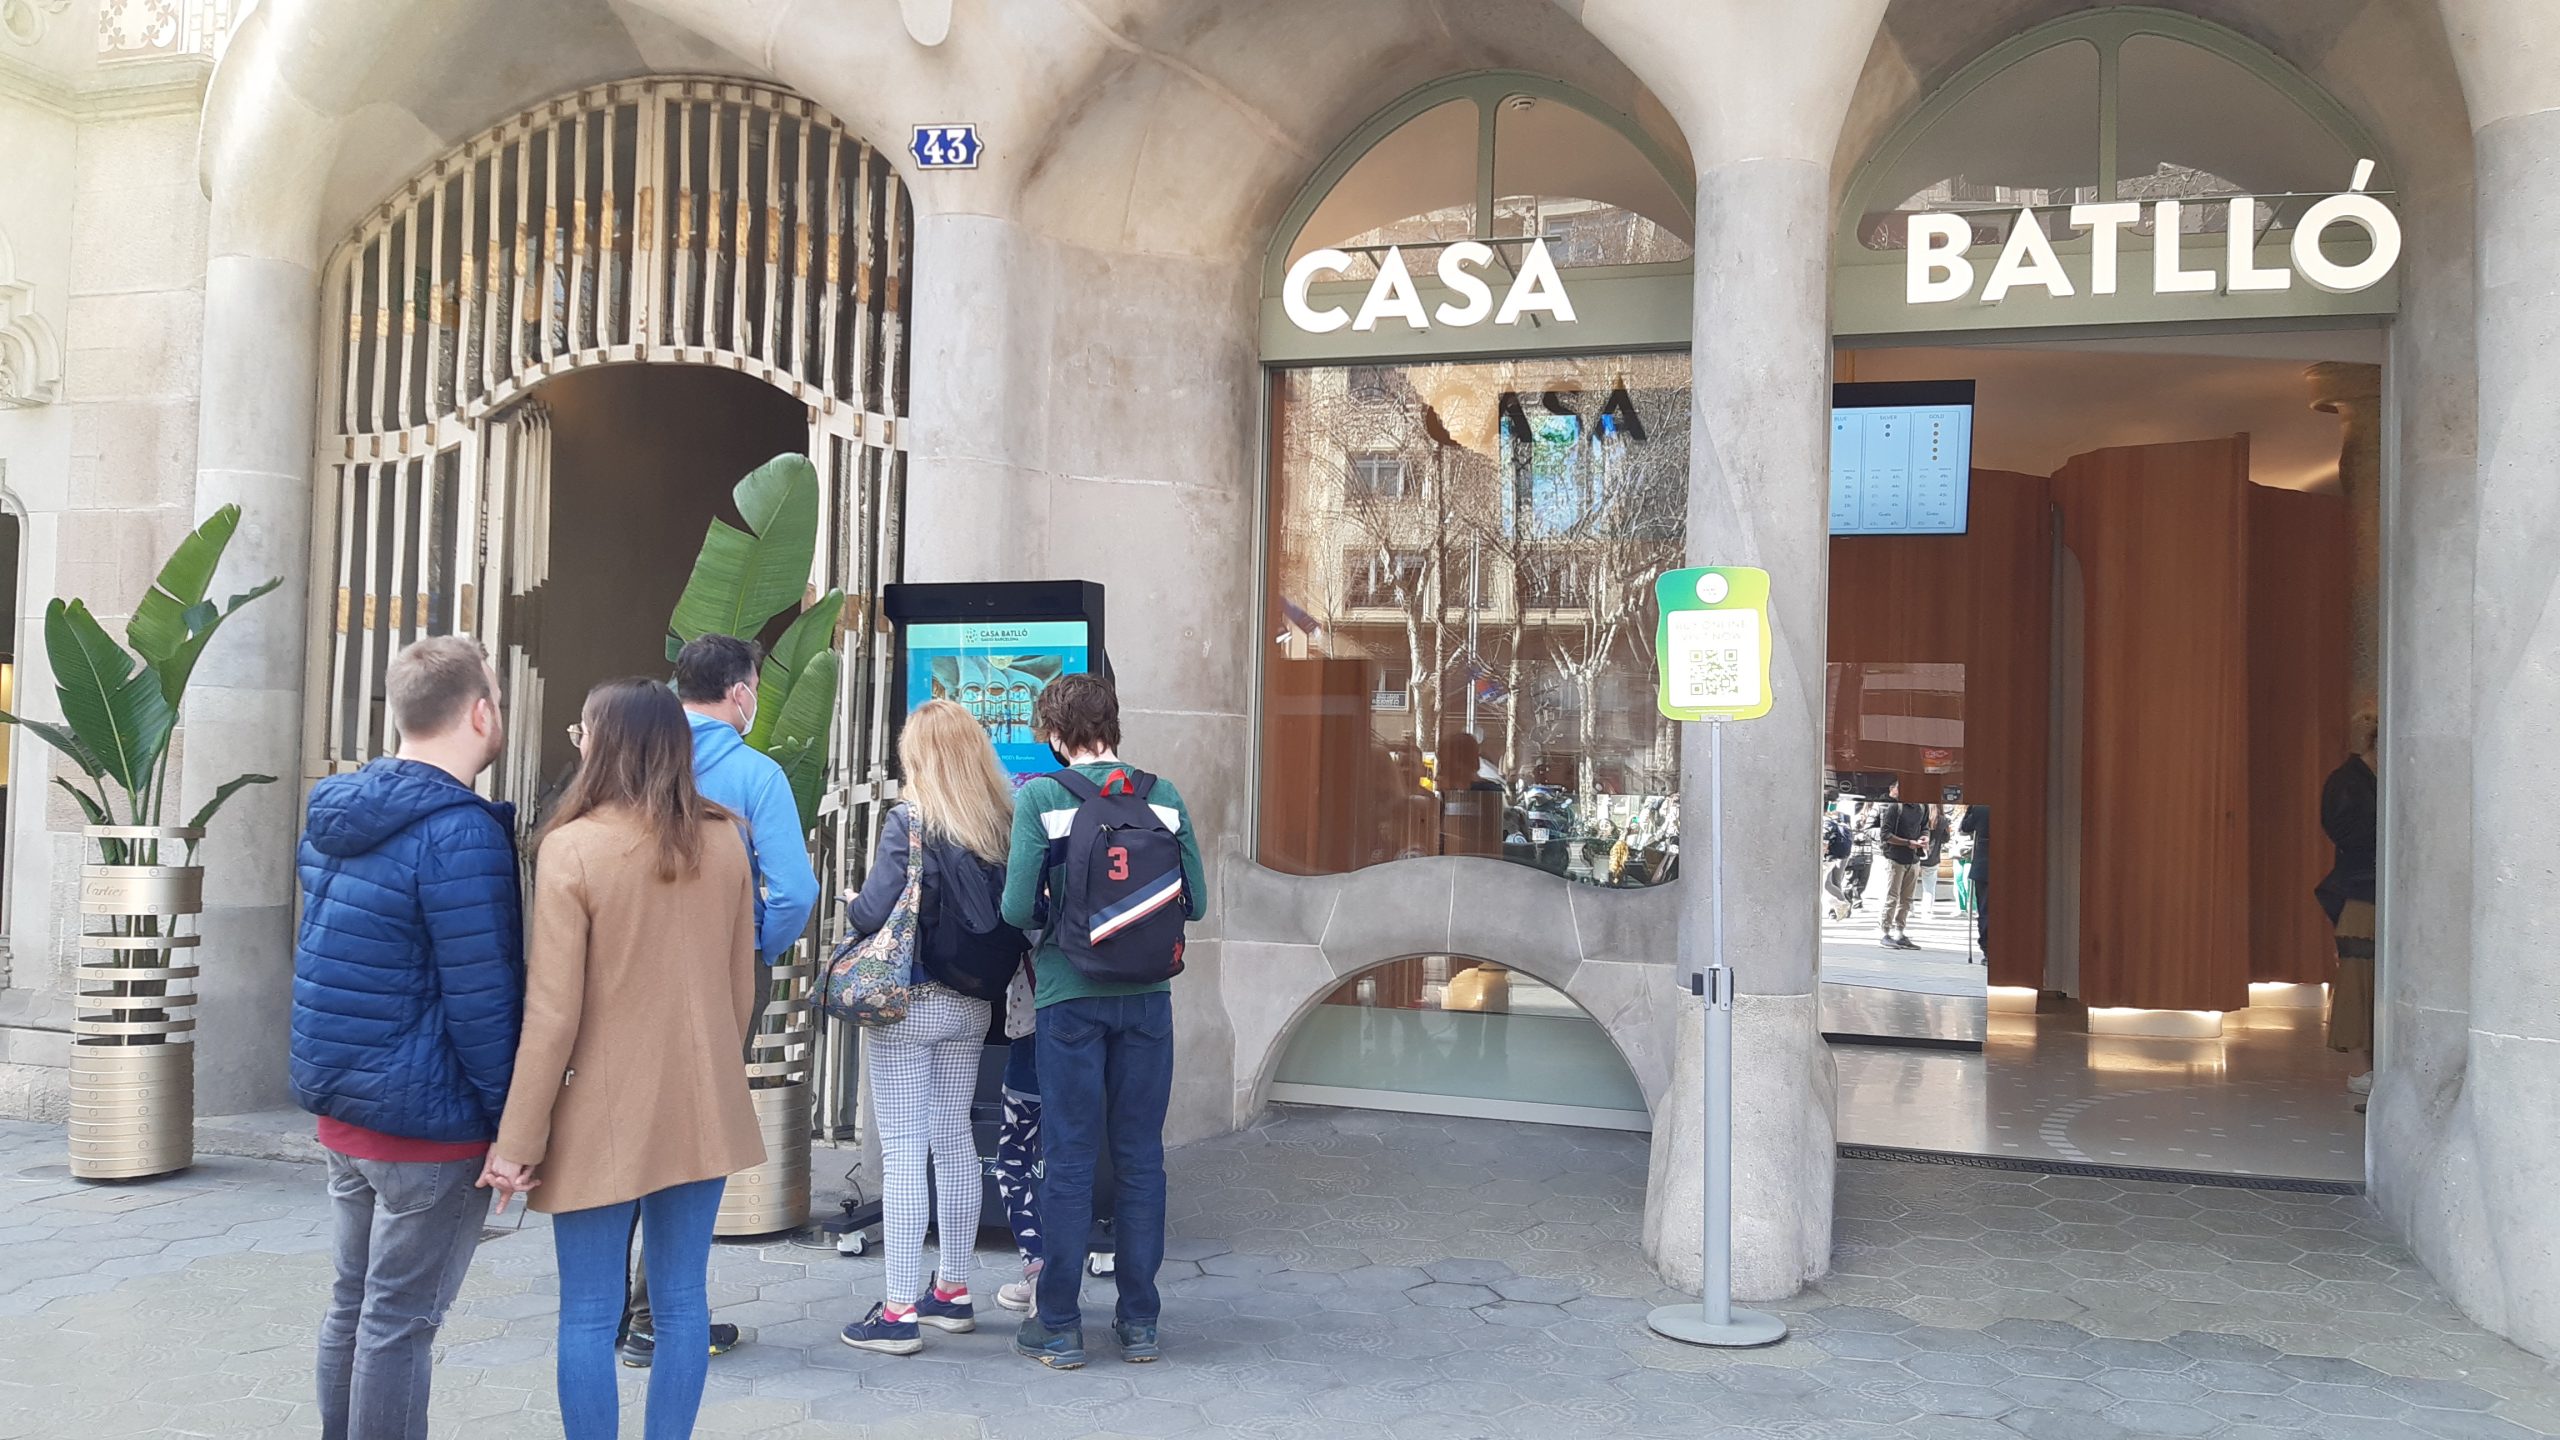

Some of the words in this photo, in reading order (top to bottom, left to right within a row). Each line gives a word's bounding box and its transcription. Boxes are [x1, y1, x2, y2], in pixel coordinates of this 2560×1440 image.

[923, 129, 967, 164] 43
[1282, 236, 1578, 333] CASA
[1906, 158, 2401, 304] BATLLÓ
[1001, 628, 1028, 637] BATLLÓ
[1107, 846, 1129, 880] 3
[86, 881, 128, 896] Cartier
